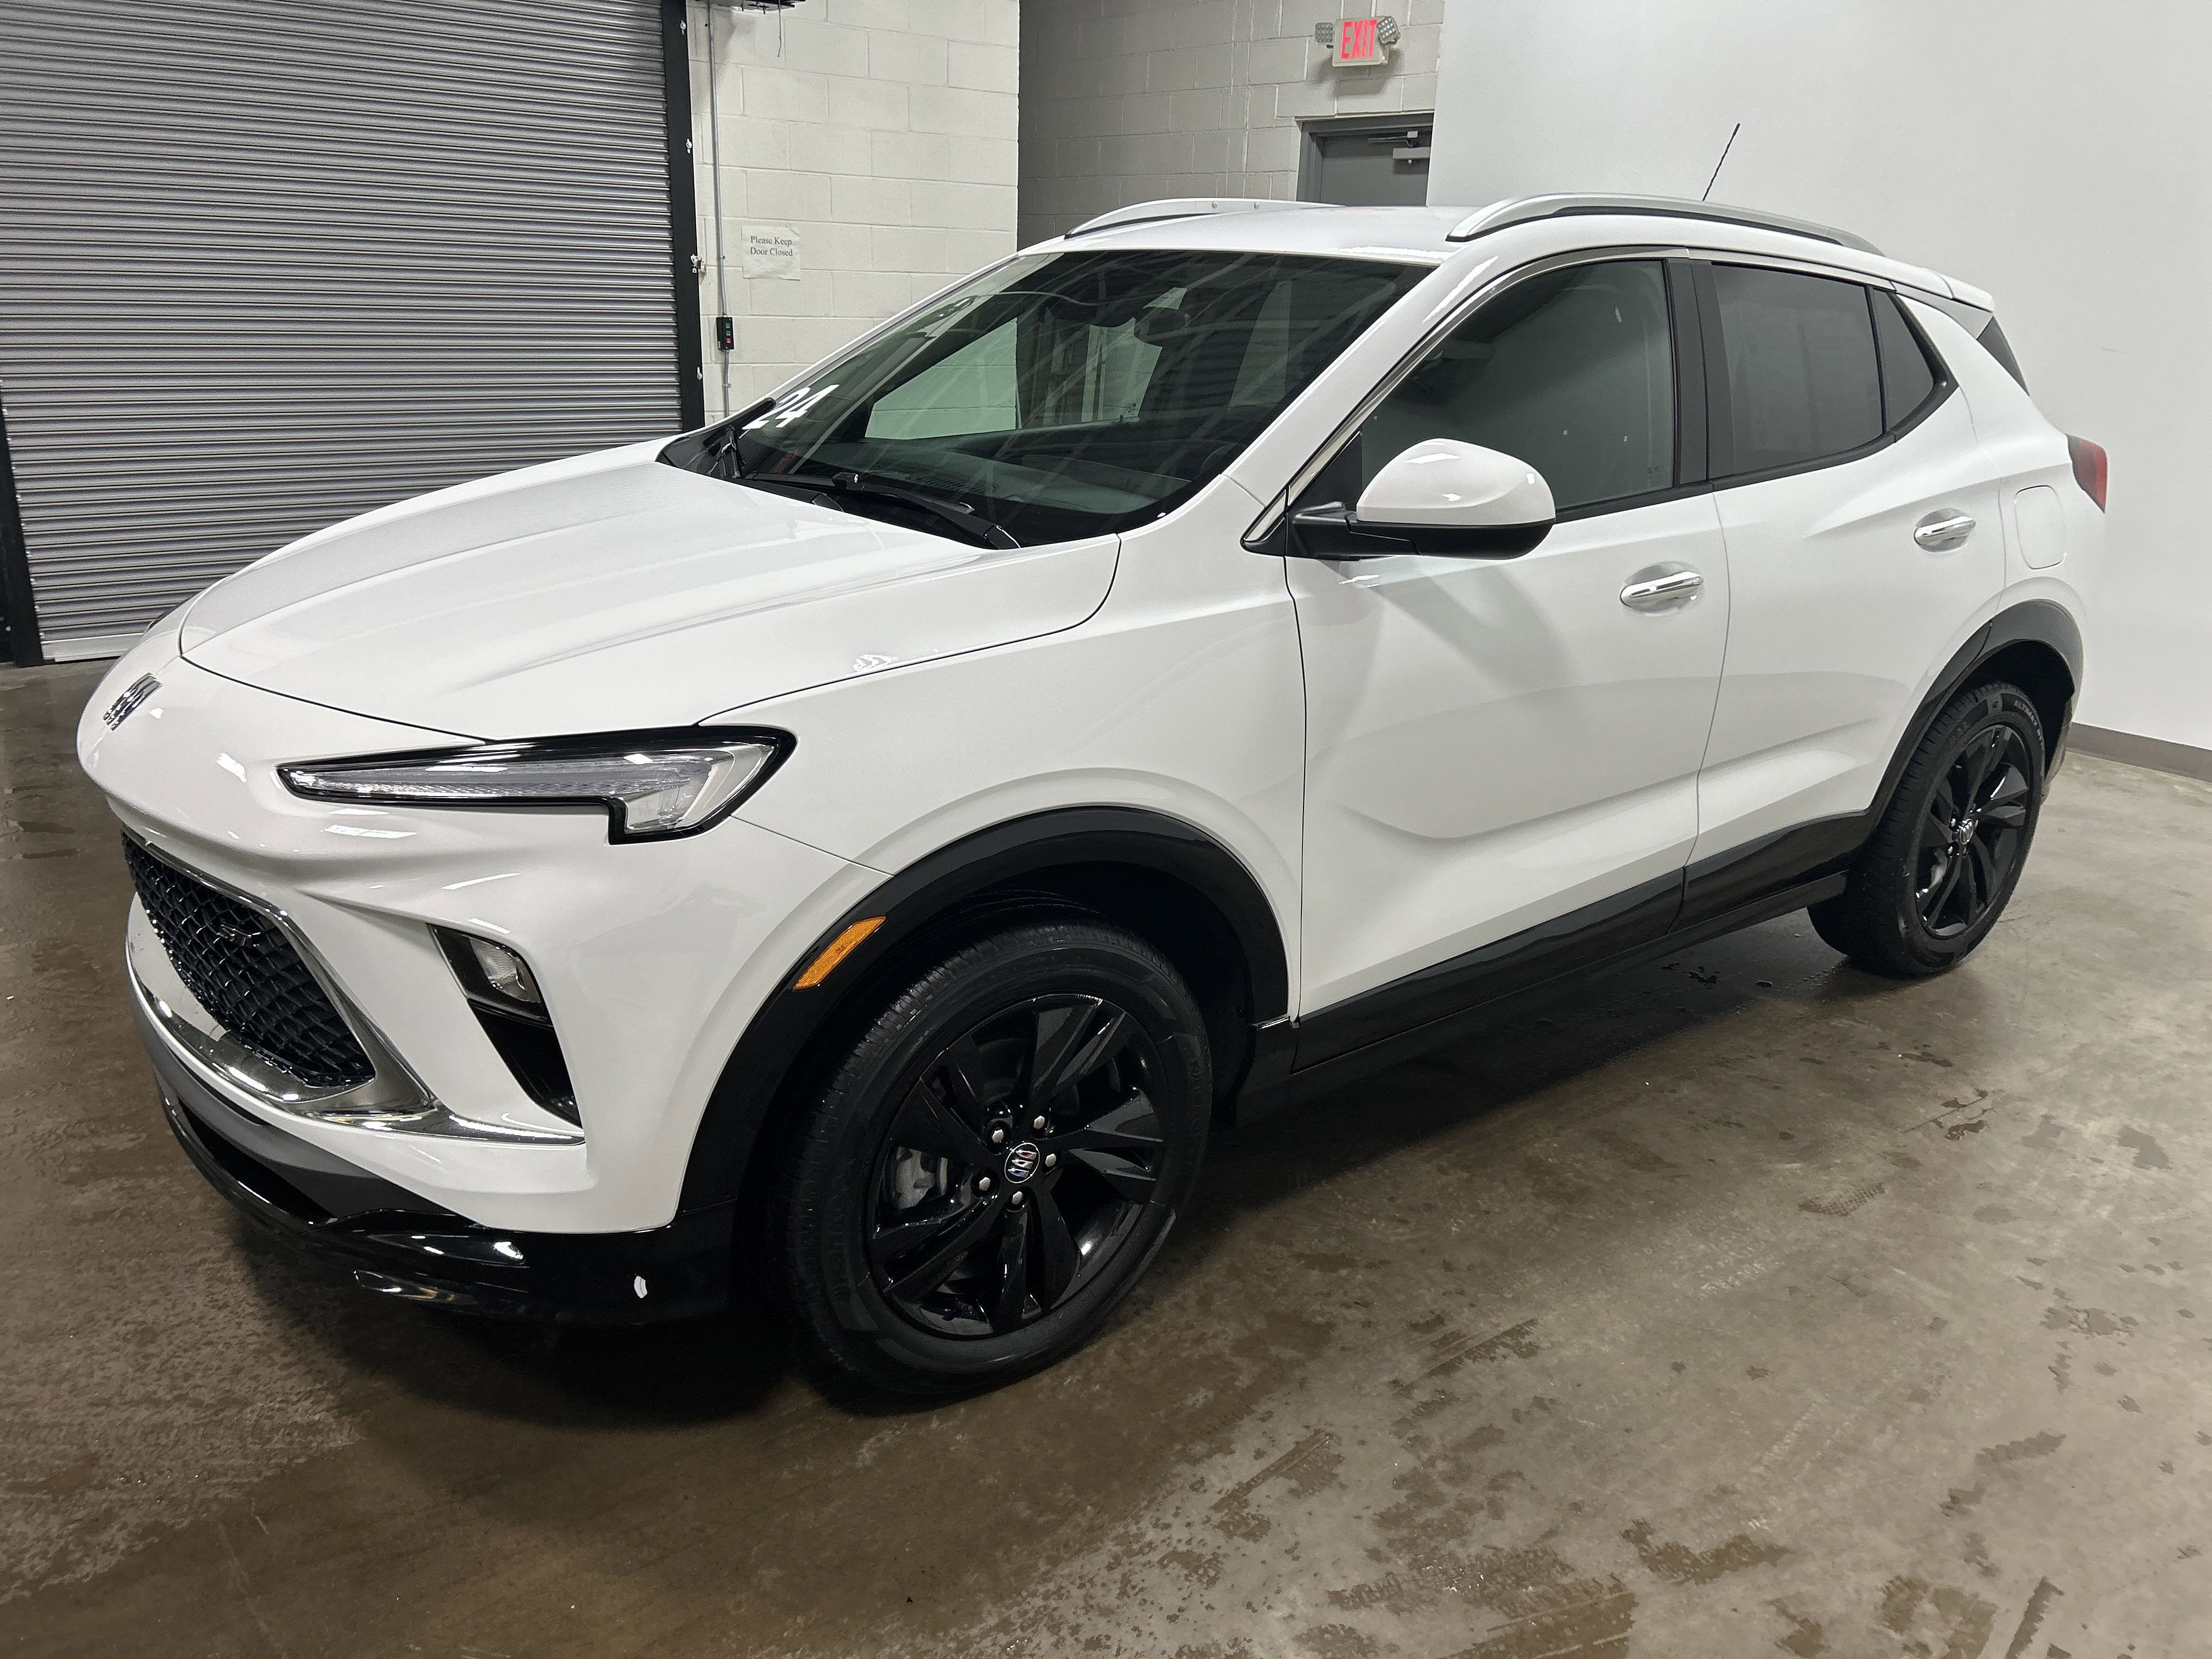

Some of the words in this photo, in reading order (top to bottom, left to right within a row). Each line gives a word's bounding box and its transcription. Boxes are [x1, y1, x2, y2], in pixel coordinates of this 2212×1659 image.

[1341, 20, 1378, 59] EXIT
[751, 235, 772, 244] Please
[775, 237, 792, 247] Keep
[751, 247, 768, 255] Door
[770, 248, 793, 256] Closed
[742, 384, 840, 430] 24
